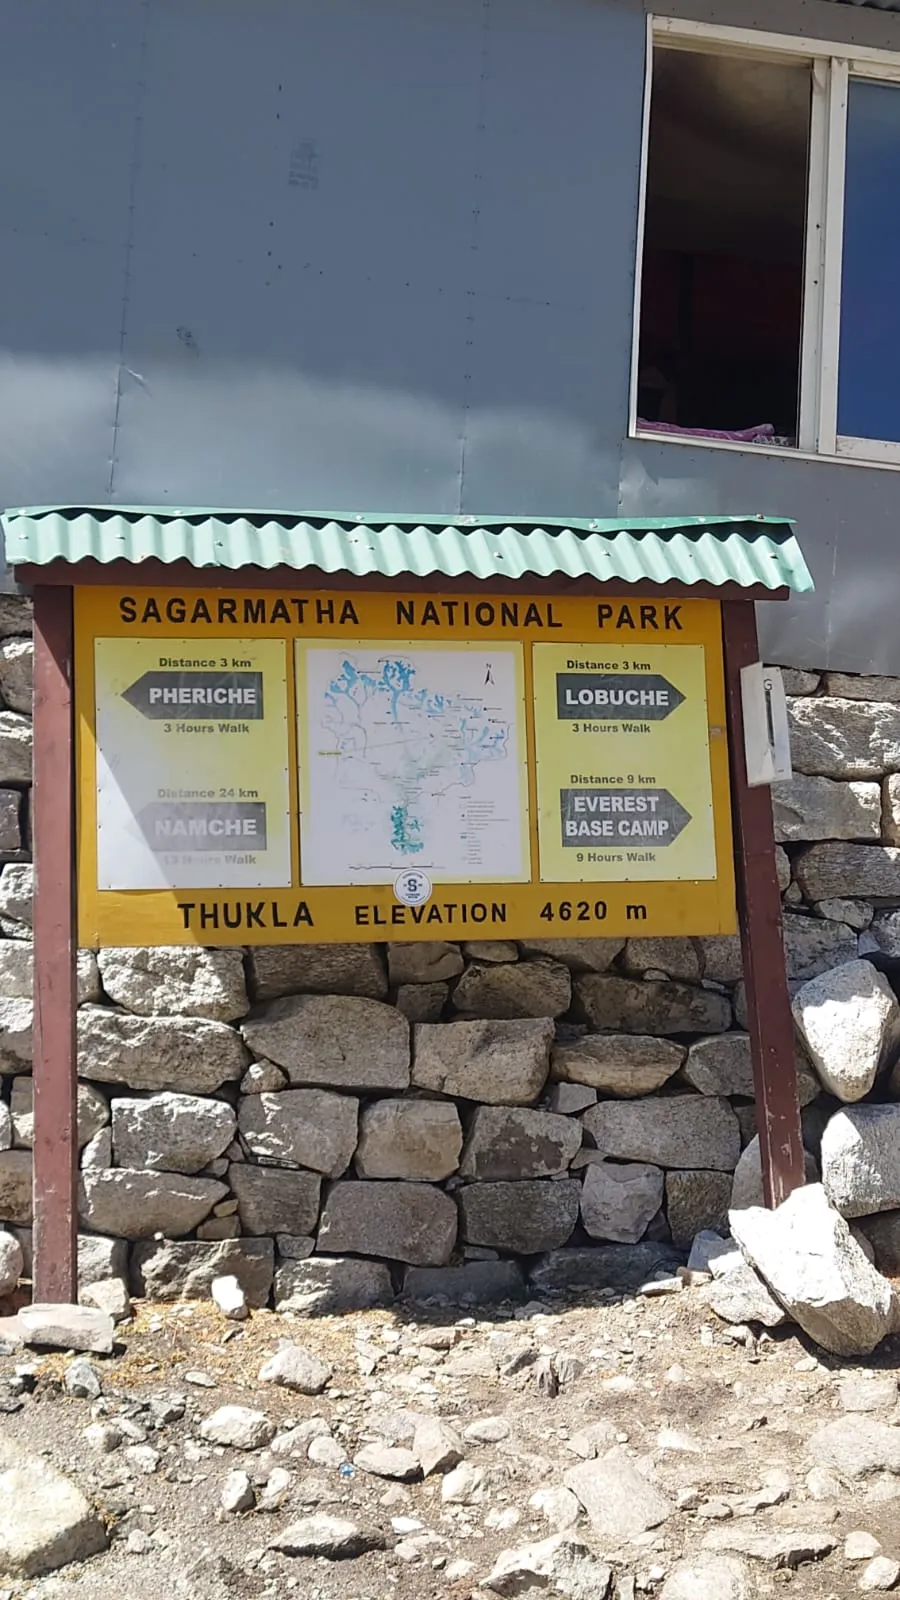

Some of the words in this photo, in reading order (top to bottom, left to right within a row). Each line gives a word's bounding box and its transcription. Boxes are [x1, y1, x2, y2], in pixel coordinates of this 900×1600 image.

[119, 596, 359, 625] SAGARMATHA
[396, 600, 563, 627] NATIONAL
[597, 604, 683, 630] PARK
[158, 657, 216, 668] Distance
[220, 658, 228, 668] 3
[232, 657, 252, 668] km
[566, 660, 619, 670] Distance
[622, 660, 630, 670] 3
[633, 660, 651, 671] km
[149, 687, 257, 705] PHERICHE
[565, 688, 670, 706] LOBUCHE
[163, 723, 171, 733] 3
[176, 723, 214, 733] Hours
[218, 723, 250, 733] Walk
[572, 723, 580, 733] 3
[583, 723, 618, 733] Hours
[621, 723, 651, 734] Walk
[569, 774, 623, 785] Distance
[626, 775, 634, 785] 9
[637, 774, 656, 784] km
[157, 788, 215, 798] Distance
[219, 788, 235, 798] 24
[239, 788, 258, 798] km
[573, 796, 659, 813] EVEREST
[155, 819, 257, 836] NAMCHE
[565, 820, 613, 837] BASE
[618, 819, 669, 837] CAMP
[224, 854, 257, 865] Walk
[576, 853, 584, 863] 9
[587, 853, 623, 863] Hours
[626, 852, 656, 863] Walk
[407, 878, 417, 892] S
[177, 901, 314, 929] THUKLA
[355, 903, 507, 925] ELEVATION
[539, 900, 607, 922] 4620
[626, 903, 647, 920] m
